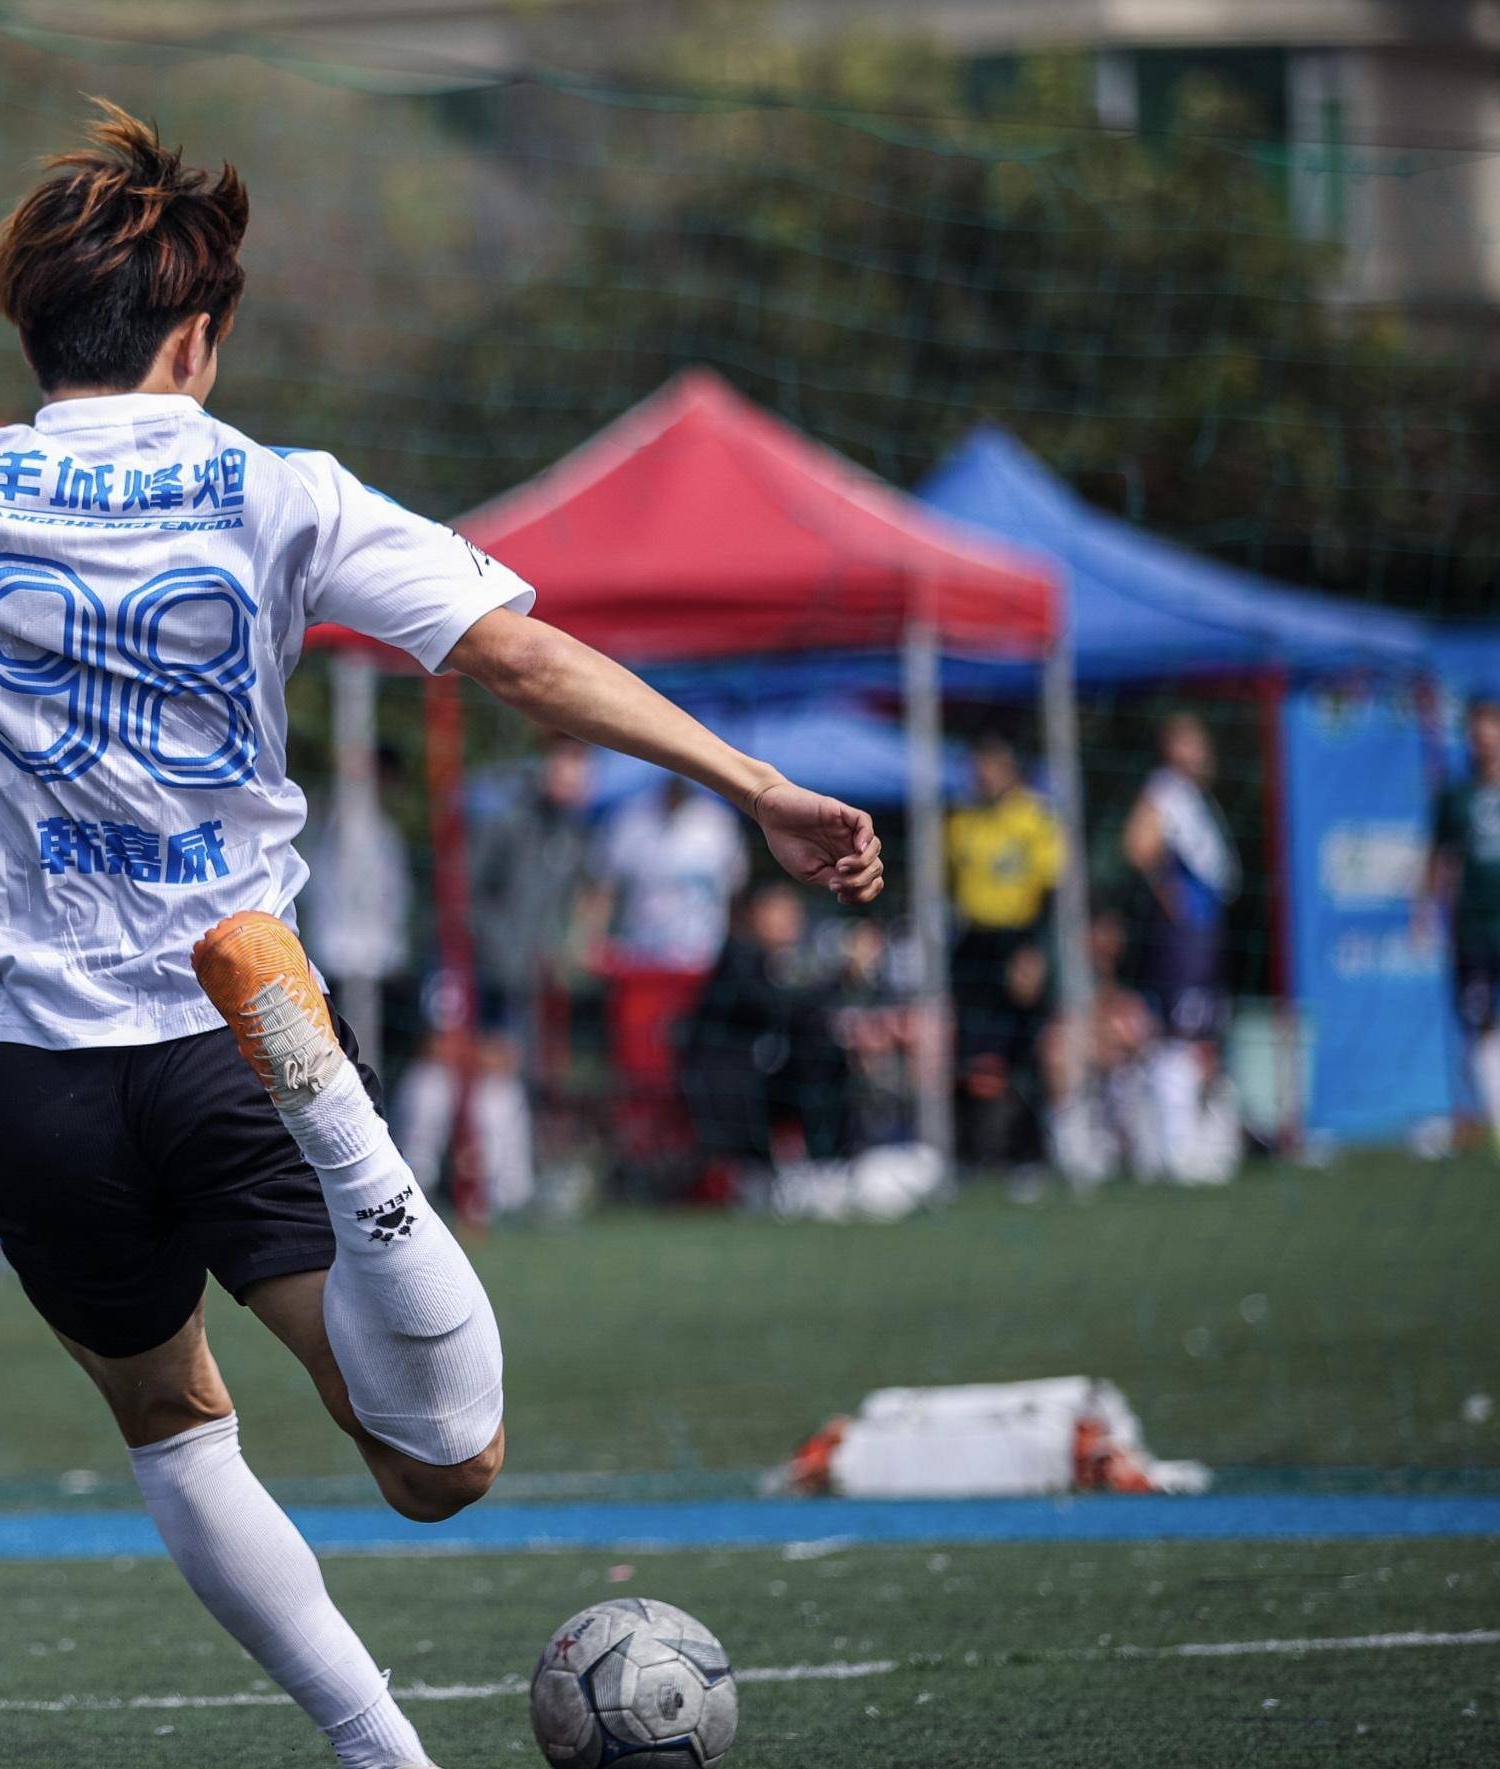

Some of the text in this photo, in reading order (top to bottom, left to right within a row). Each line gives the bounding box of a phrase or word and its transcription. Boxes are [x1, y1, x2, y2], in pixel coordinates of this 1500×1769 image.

[36, 816, 231, 885] 韩嘉威
[355, 1184, 414, 1221] KELME
